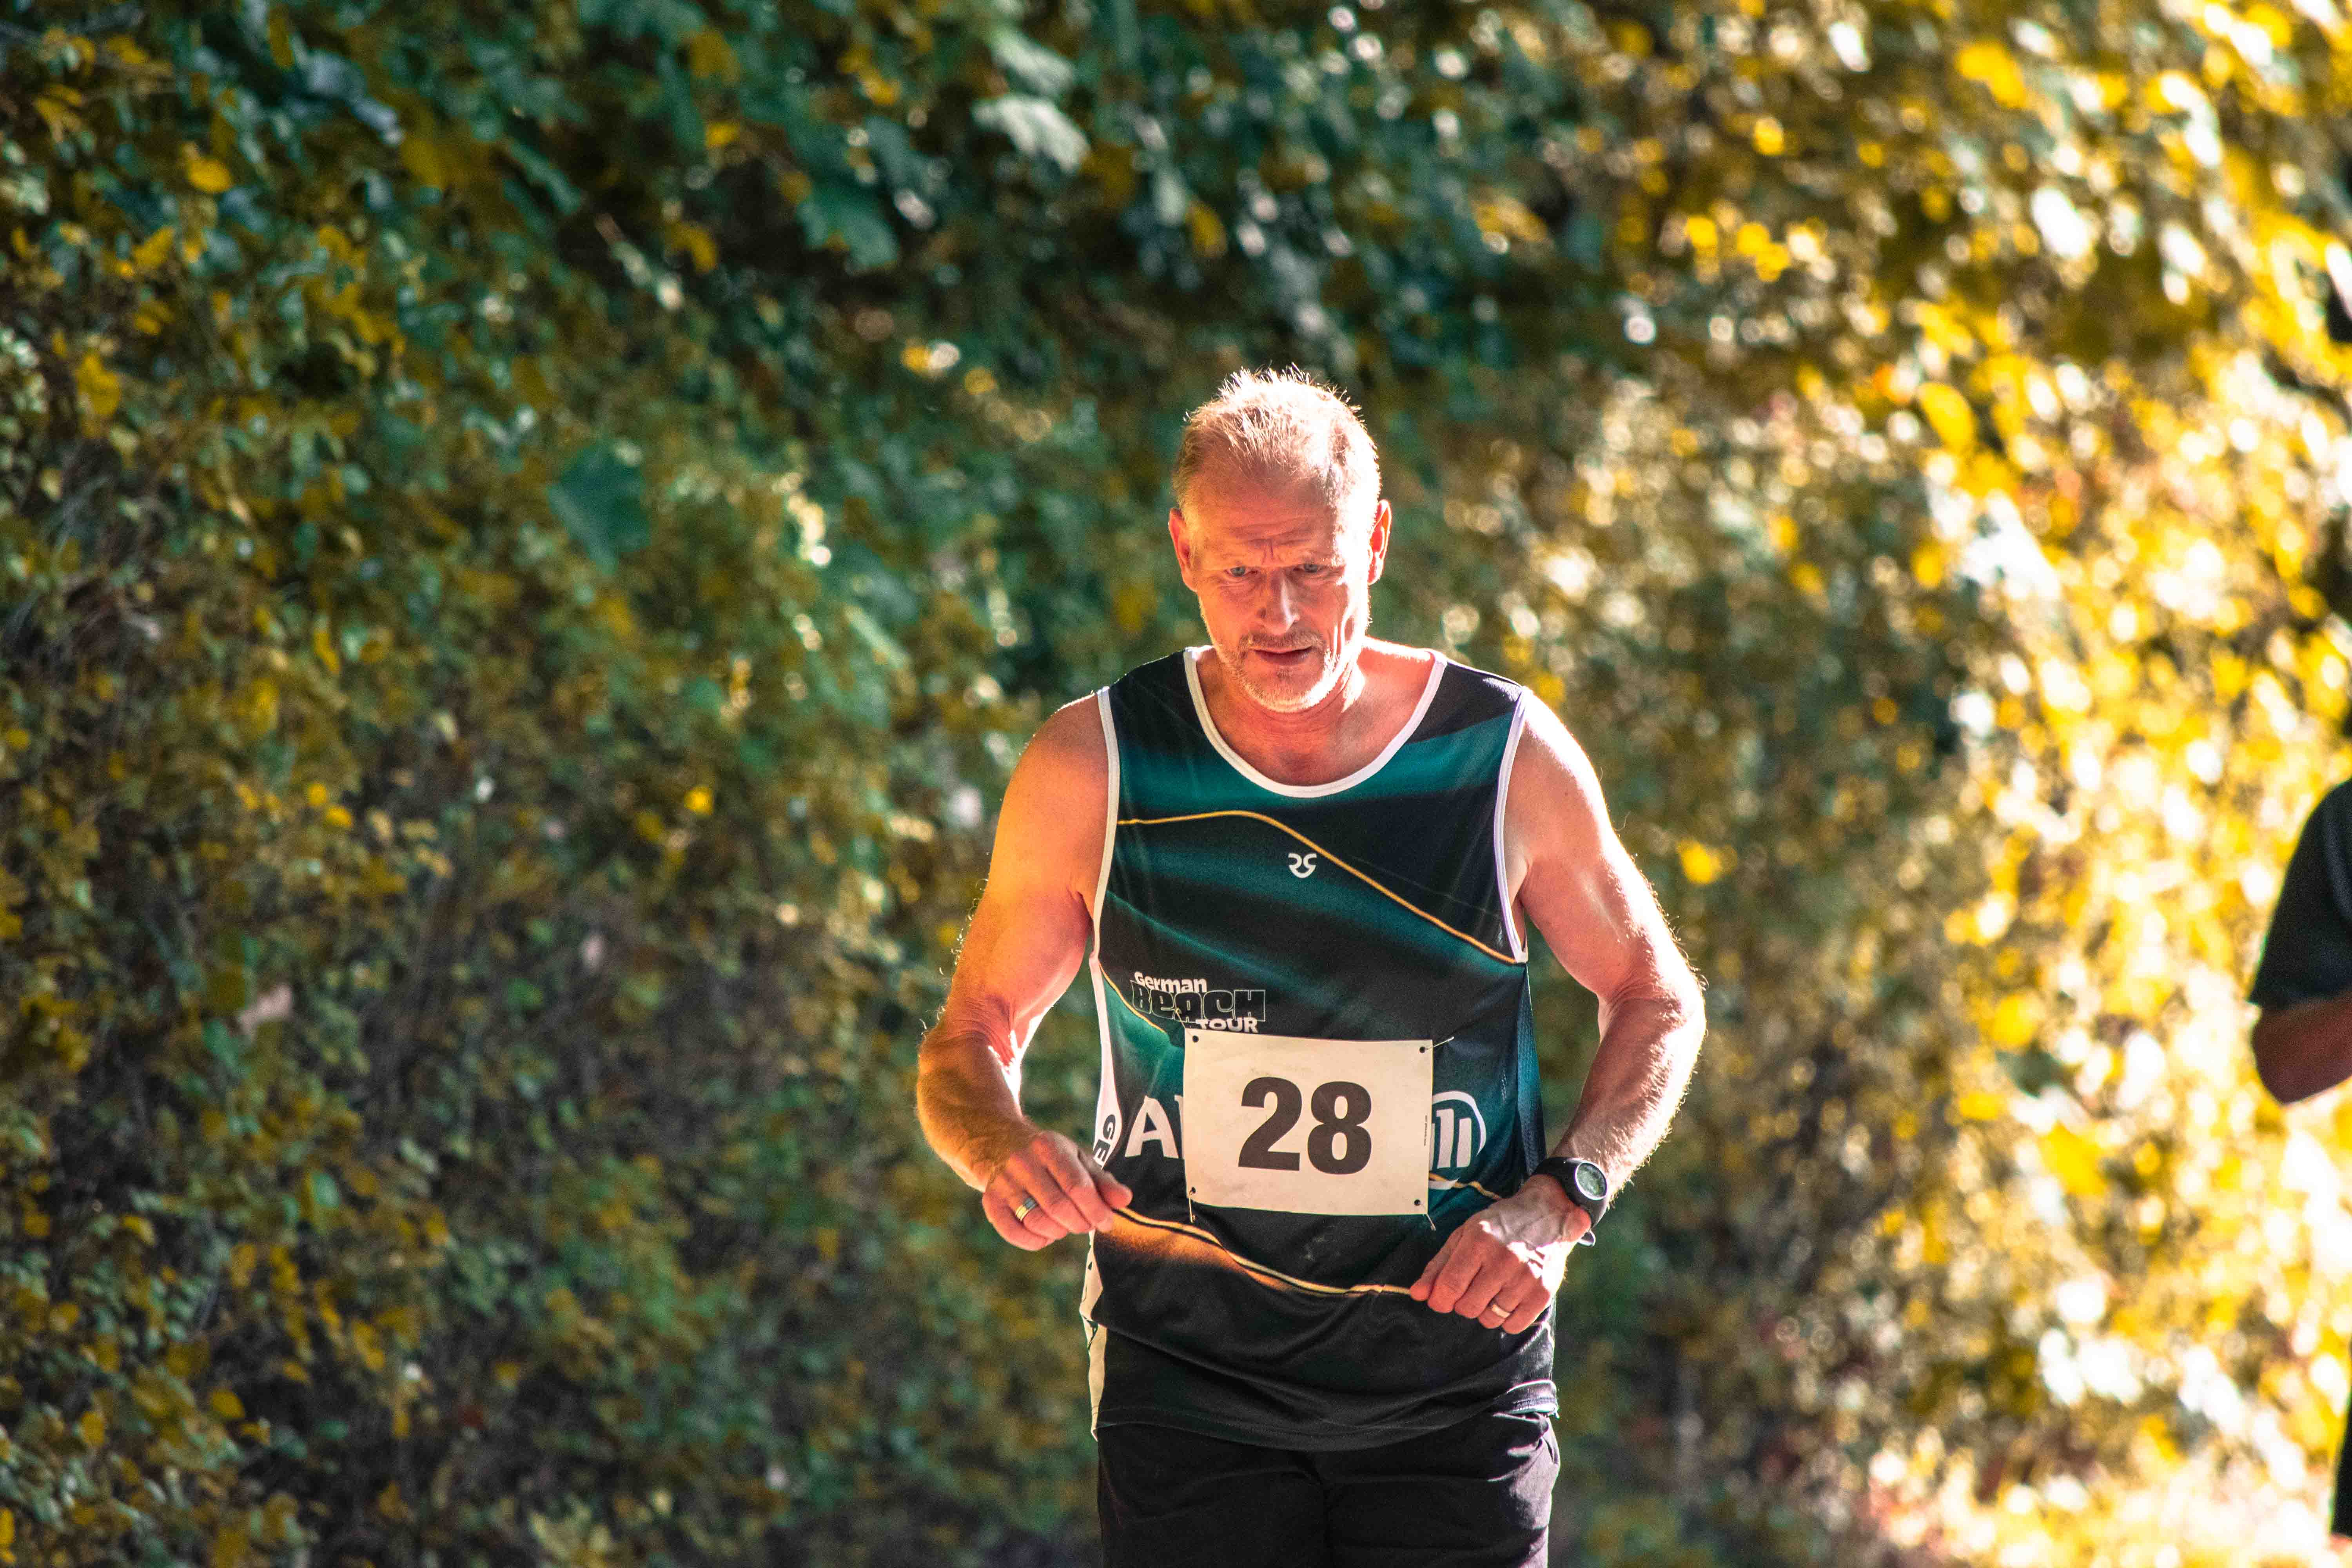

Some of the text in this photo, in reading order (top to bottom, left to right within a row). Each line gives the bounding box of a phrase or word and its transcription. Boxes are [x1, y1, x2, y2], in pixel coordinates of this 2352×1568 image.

[1134, 971, 1207, 993] German
[1196, 1017, 1259, 1033] TOUR
[1238, 1076, 1372, 1175] 28
